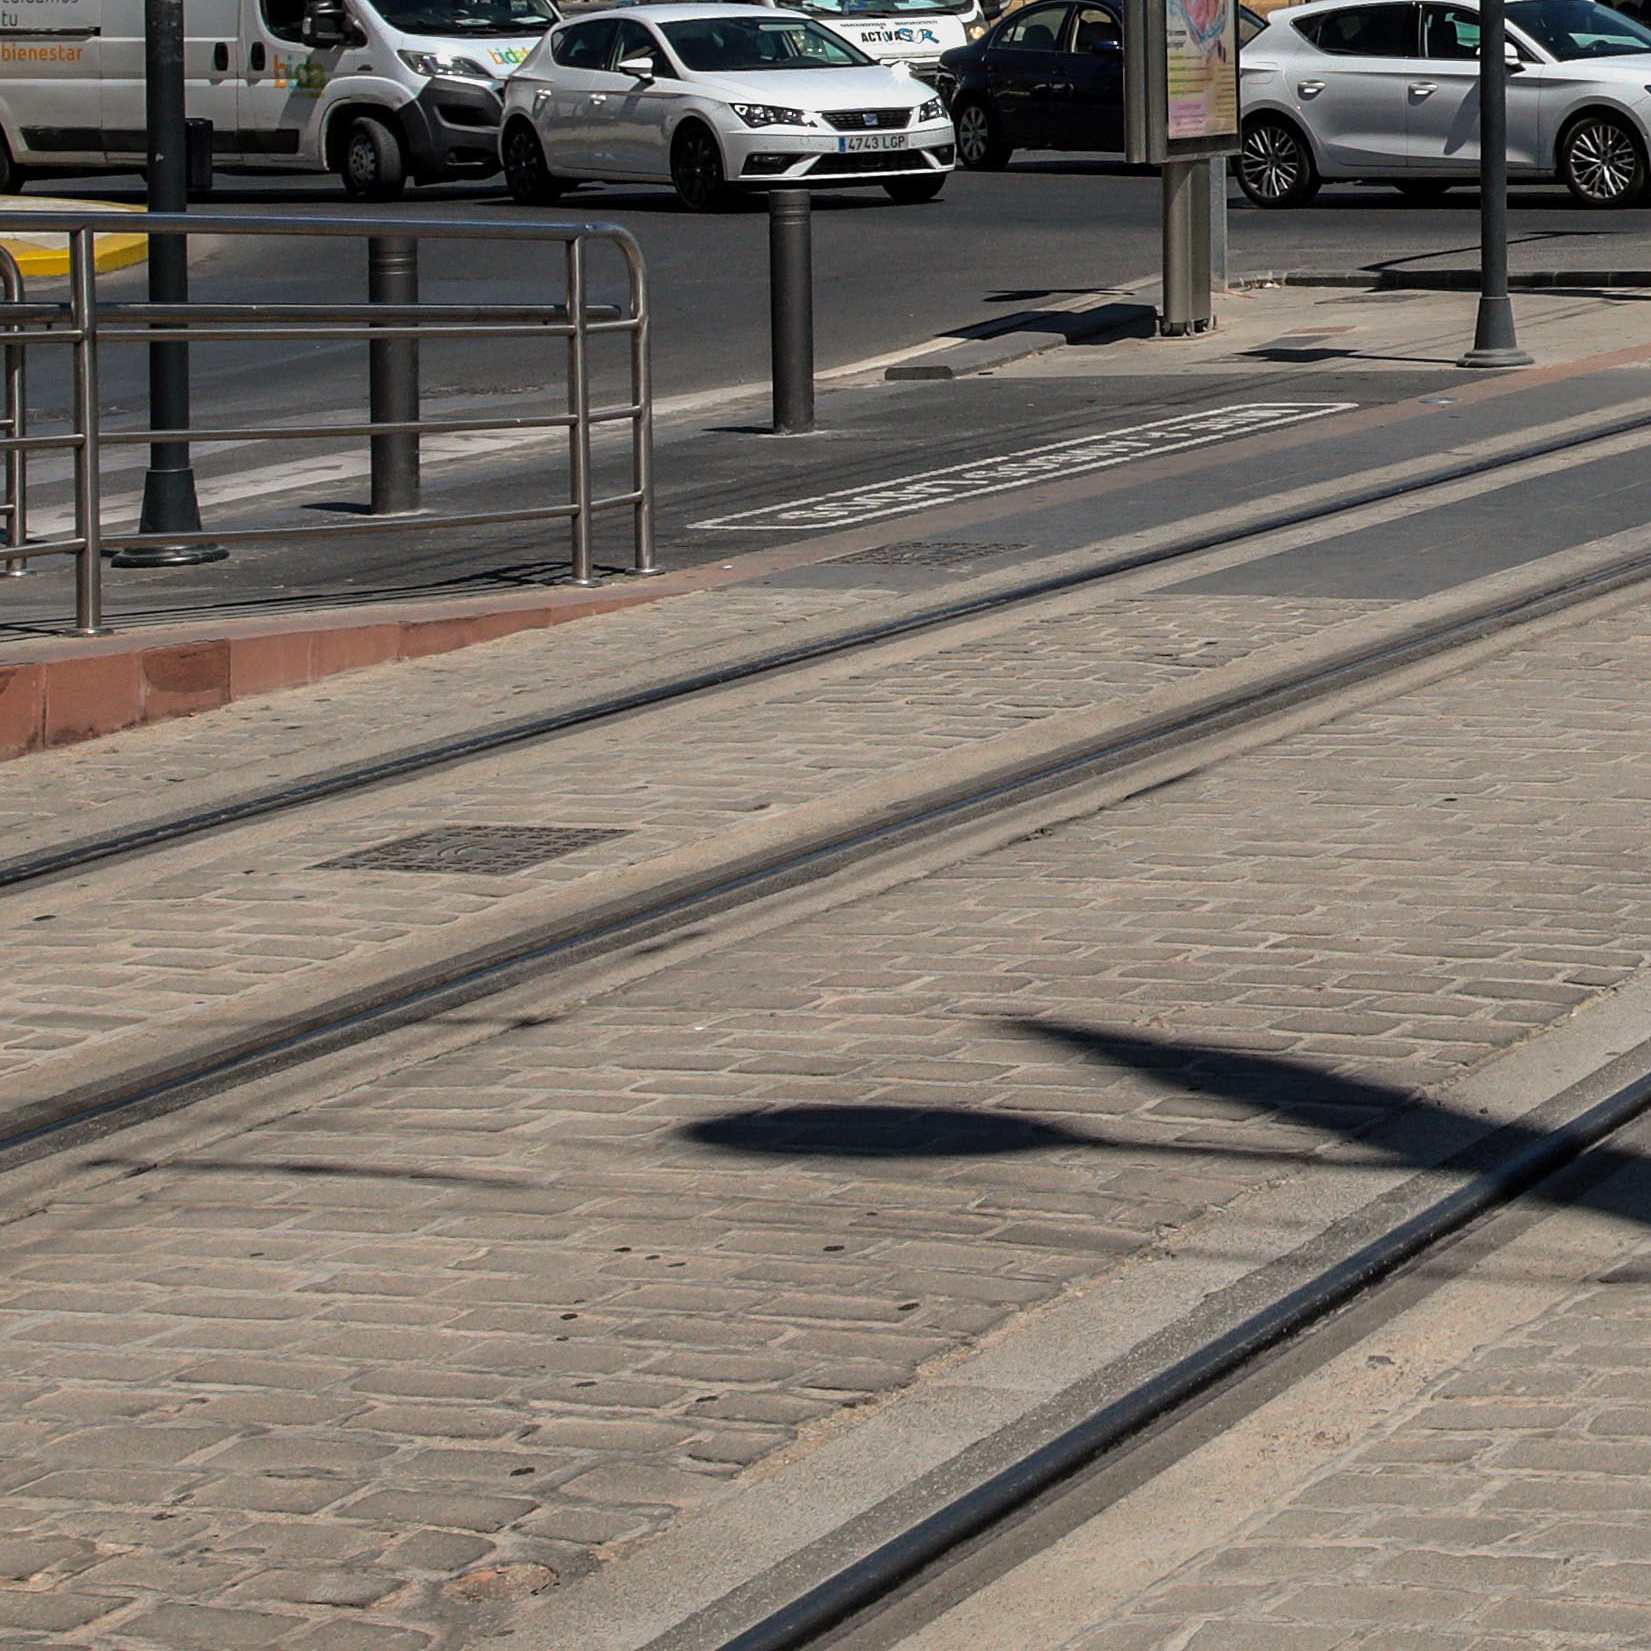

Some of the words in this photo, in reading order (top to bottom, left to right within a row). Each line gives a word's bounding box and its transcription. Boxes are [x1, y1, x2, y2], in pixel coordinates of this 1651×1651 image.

[1, 10, 18, 27] tu
[1, 42, 82, 61] bienestar
[848, 137, 879, 150] 4743
[882, 135, 905, 149] LGP
